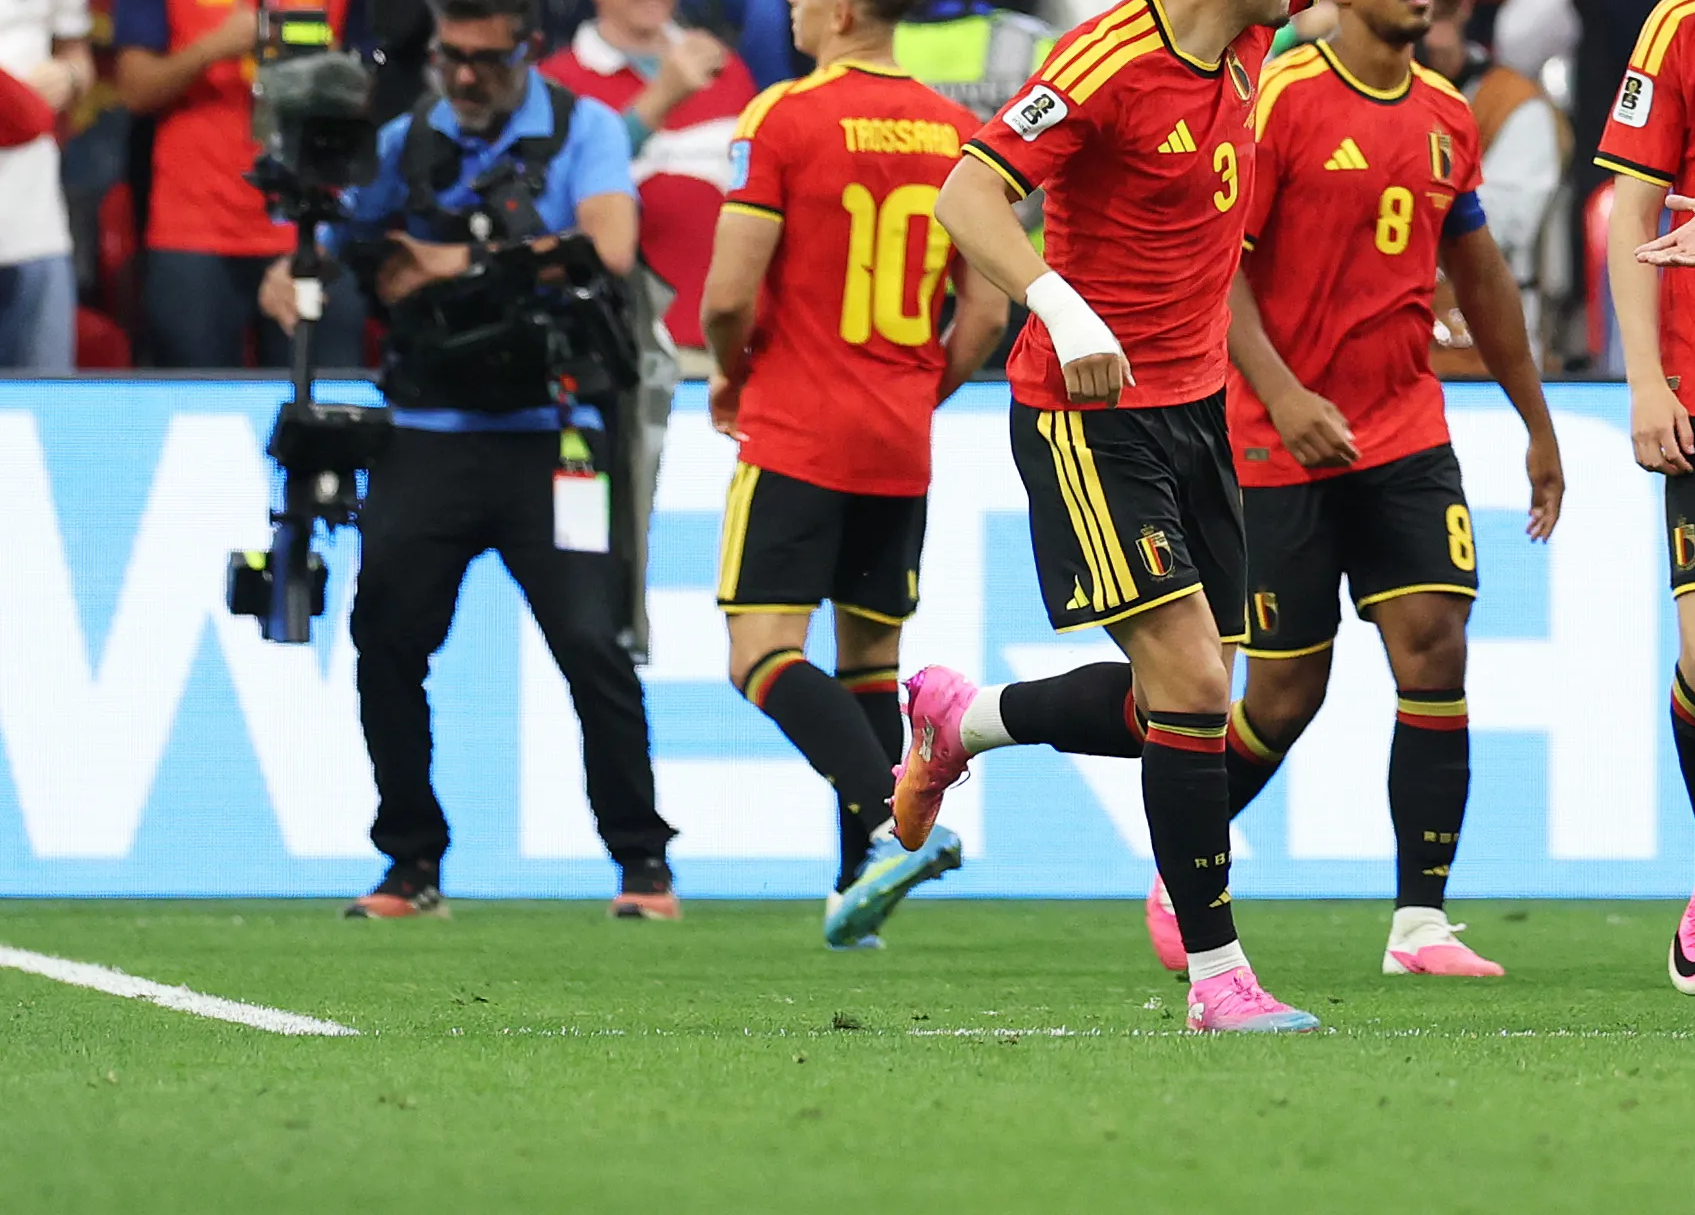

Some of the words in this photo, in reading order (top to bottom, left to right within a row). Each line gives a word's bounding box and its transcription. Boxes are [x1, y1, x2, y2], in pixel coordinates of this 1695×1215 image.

[839, 117, 960, 158] TROSSARD
[1213, 141, 1239, 213] 3
[1375, 186, 1414, 255] 8
[839, 183, 952, 346] 10
[1445, 504, 1476, 572] 8
